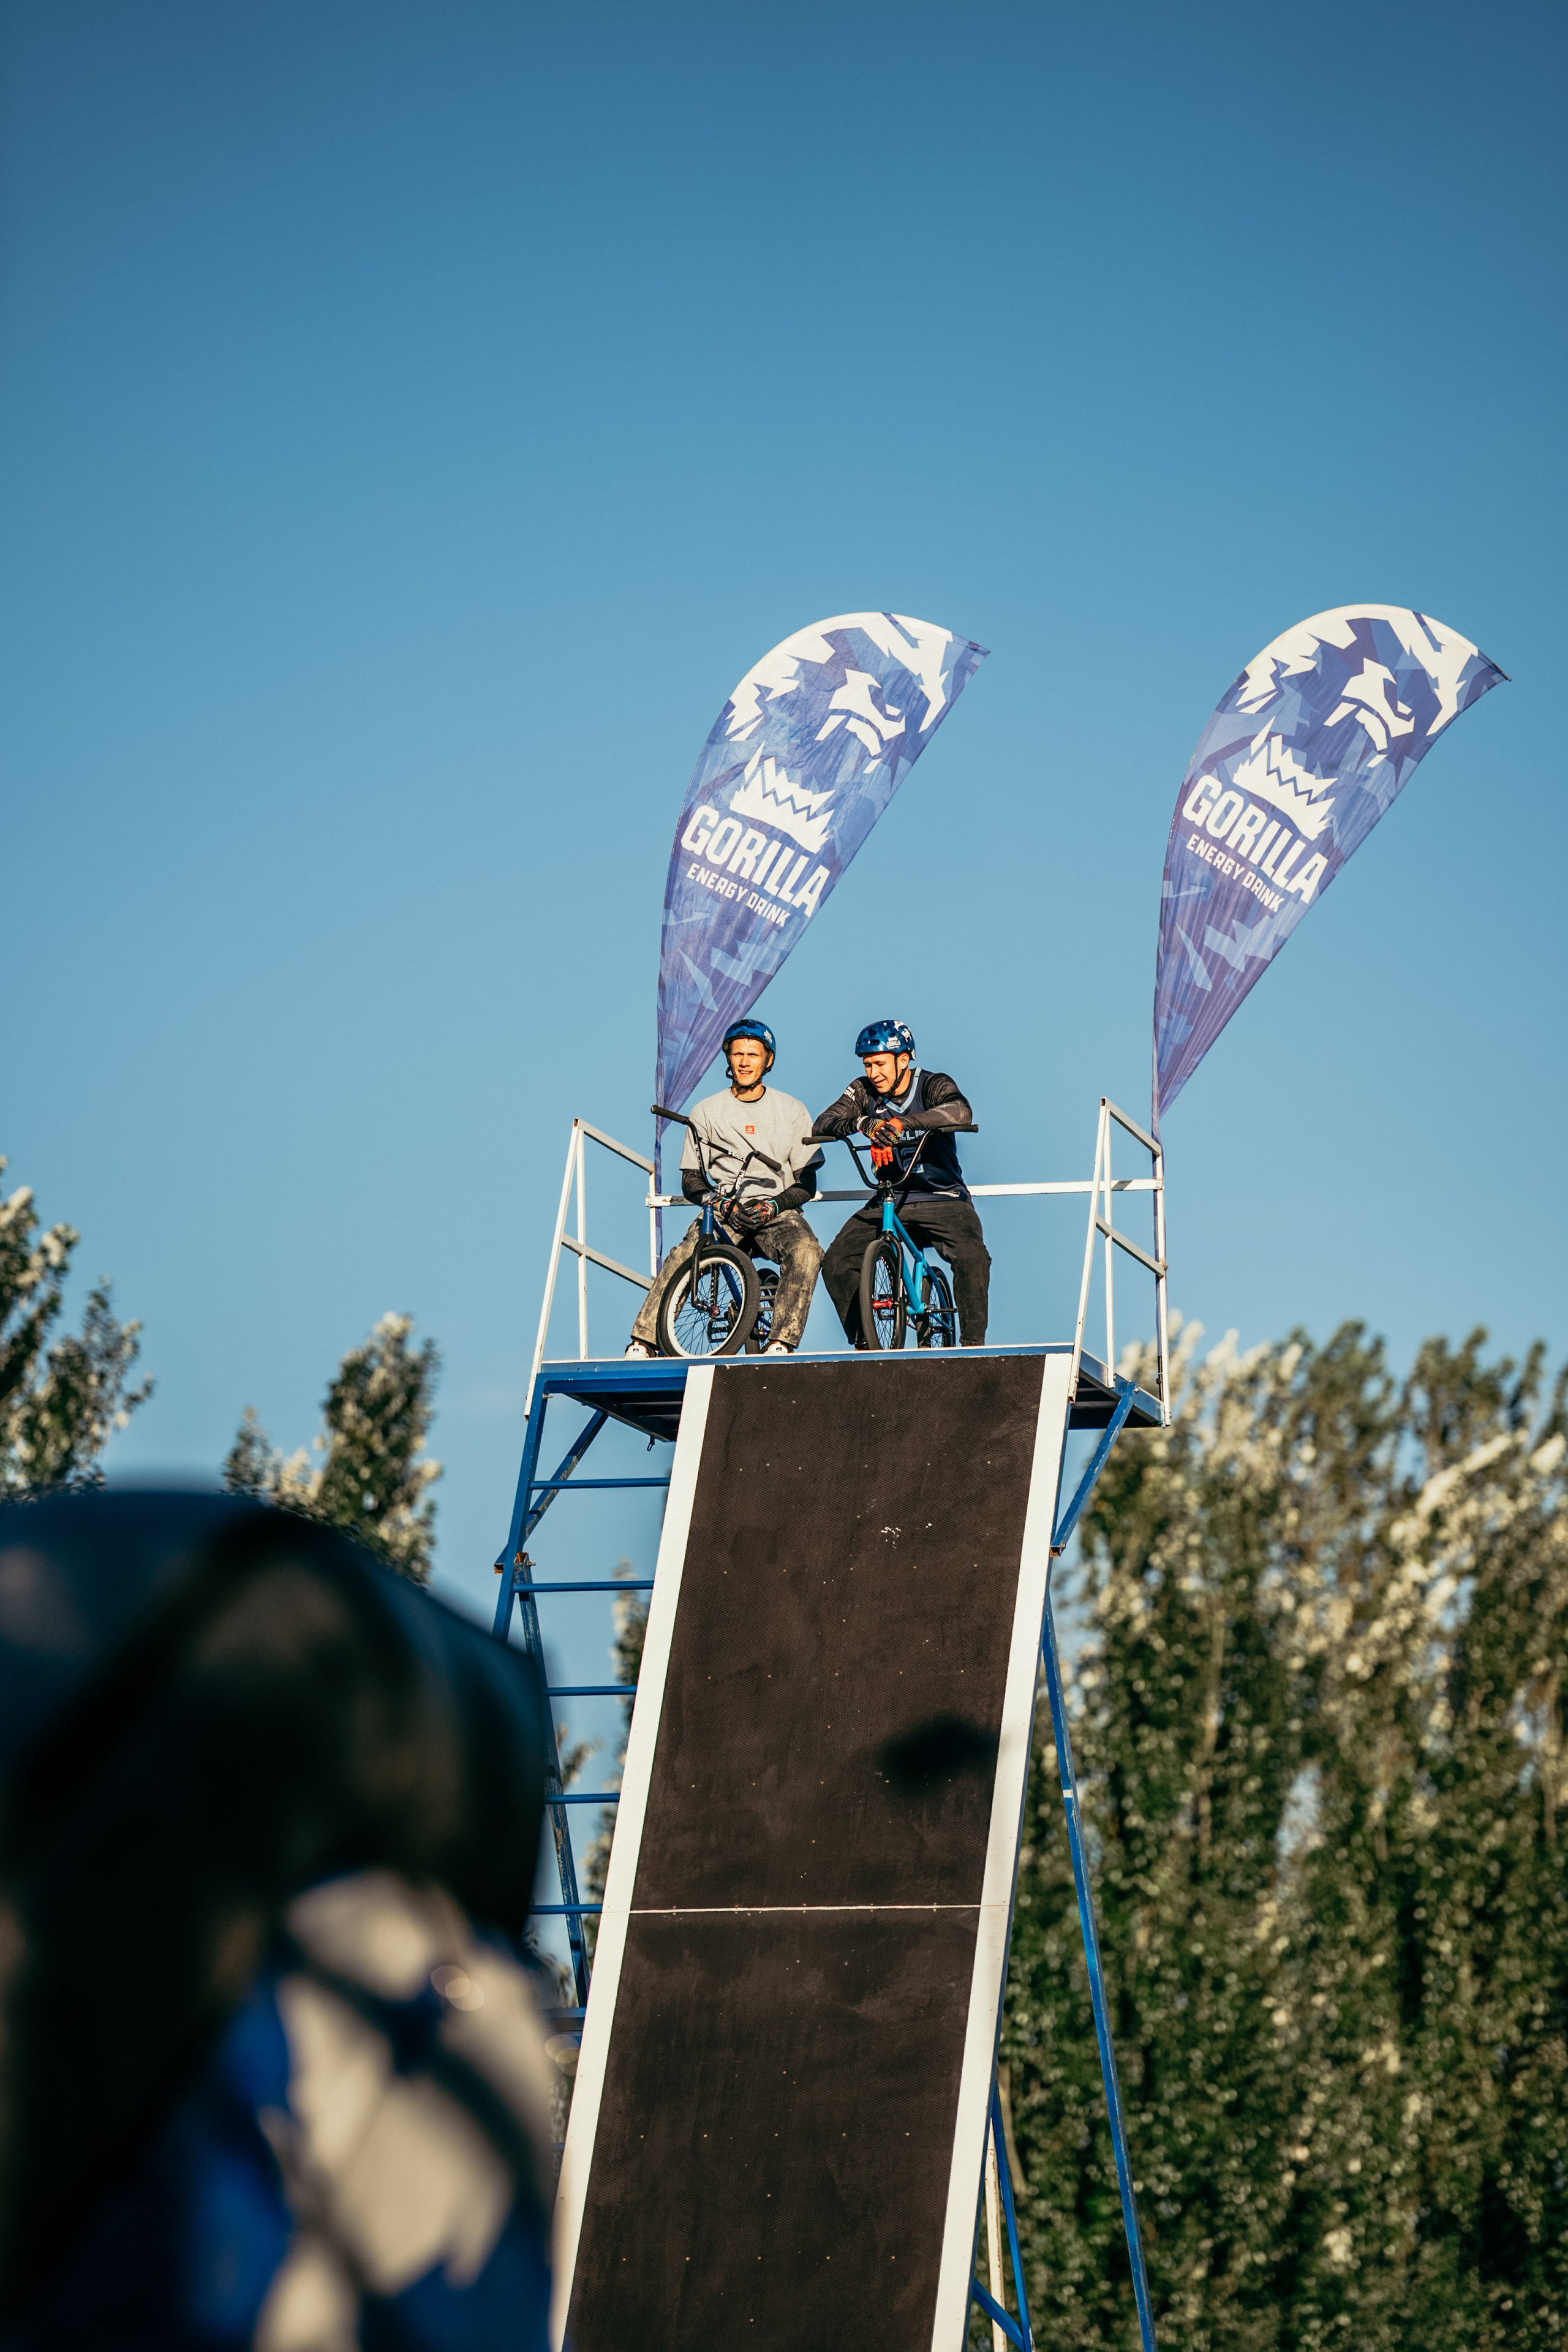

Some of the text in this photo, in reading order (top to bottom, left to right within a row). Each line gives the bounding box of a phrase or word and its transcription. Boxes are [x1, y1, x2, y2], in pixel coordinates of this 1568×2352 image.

[680, 804, 831, 918] GORILLA
[1182, 774, 1329, 905] GORILLA
[1186, 833, 1285, 913] ENERGY DRINK
[686, 862, 791, 928] ENERGY DRINK
